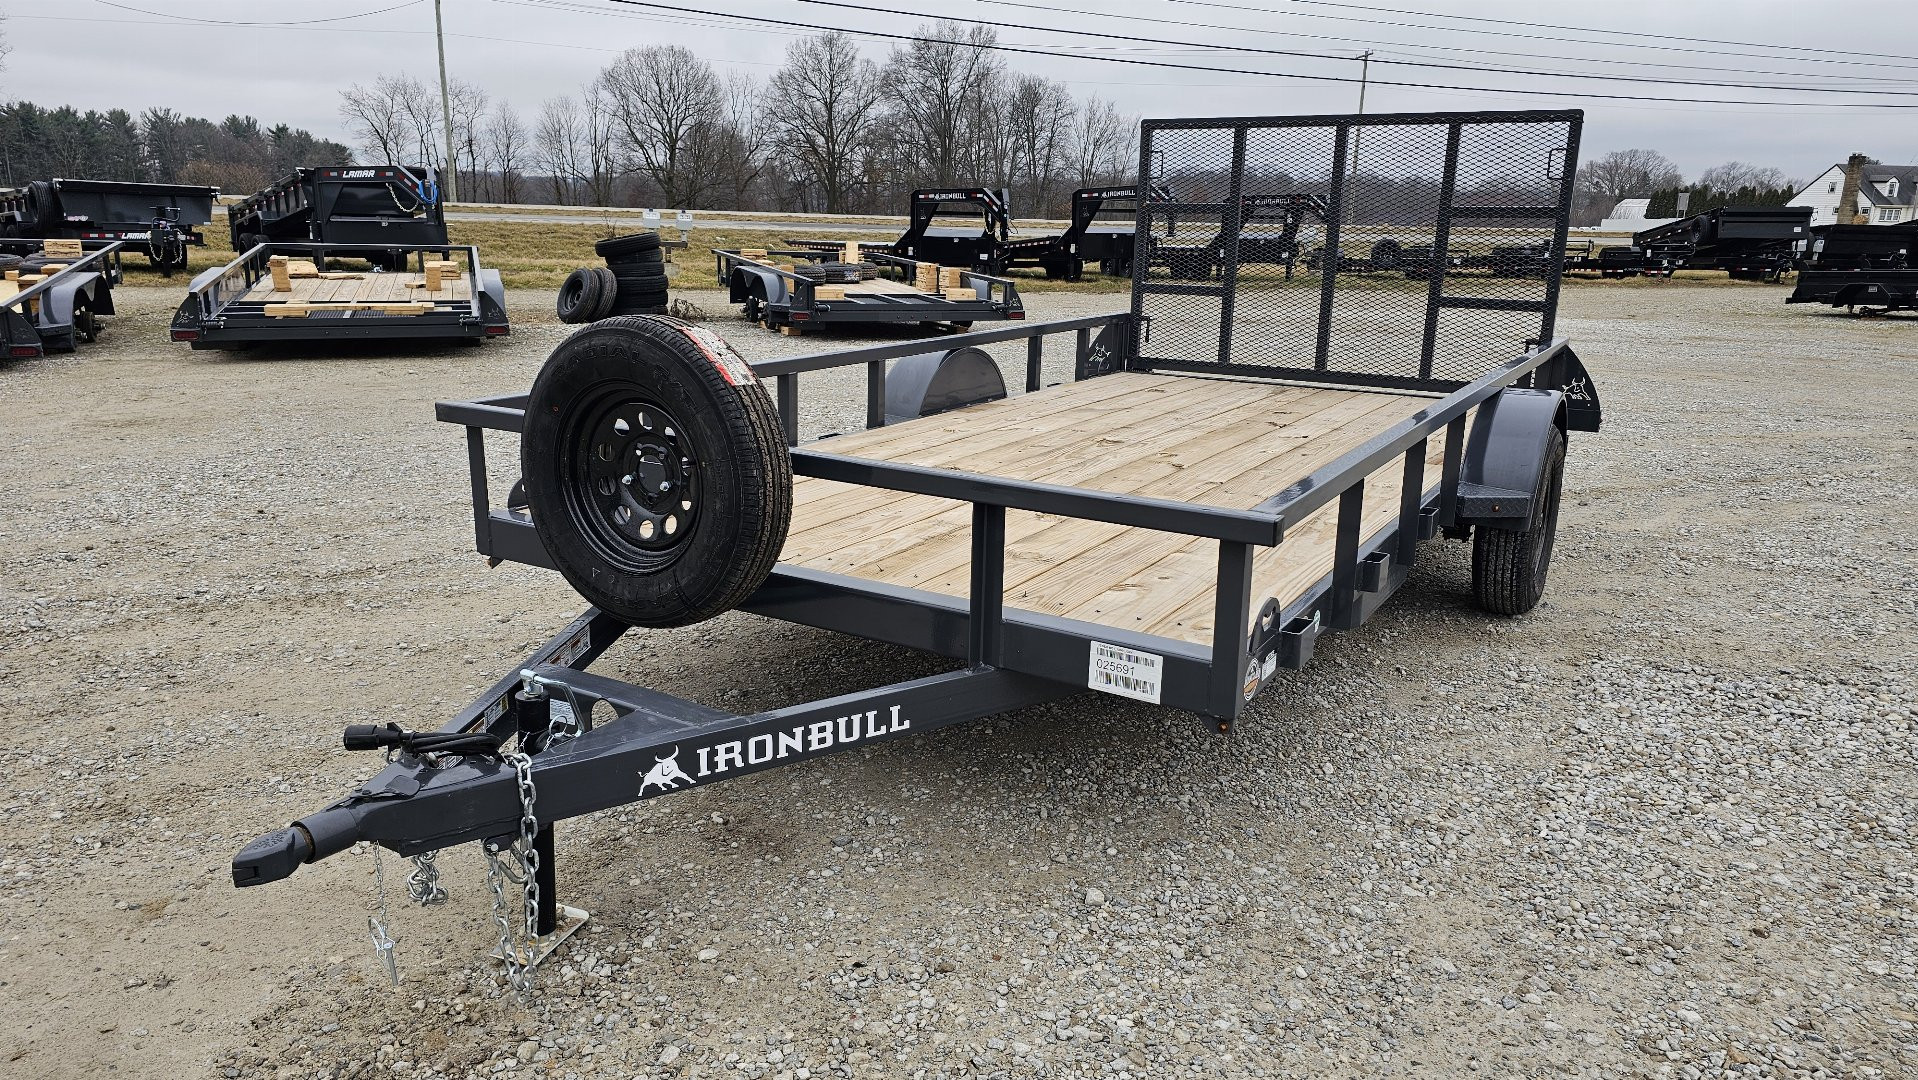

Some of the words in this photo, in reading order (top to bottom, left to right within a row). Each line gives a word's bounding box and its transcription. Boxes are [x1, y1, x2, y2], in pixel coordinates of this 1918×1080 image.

[342, 169, 376, 178] LAMAR
[940, 192, 967, 200] IRONBULL
[1107, 189, 1136, 197] IRONBULL
[1096, 658, 1135, 676] 025691
[696, 704, 911, 777] IRONBULL
